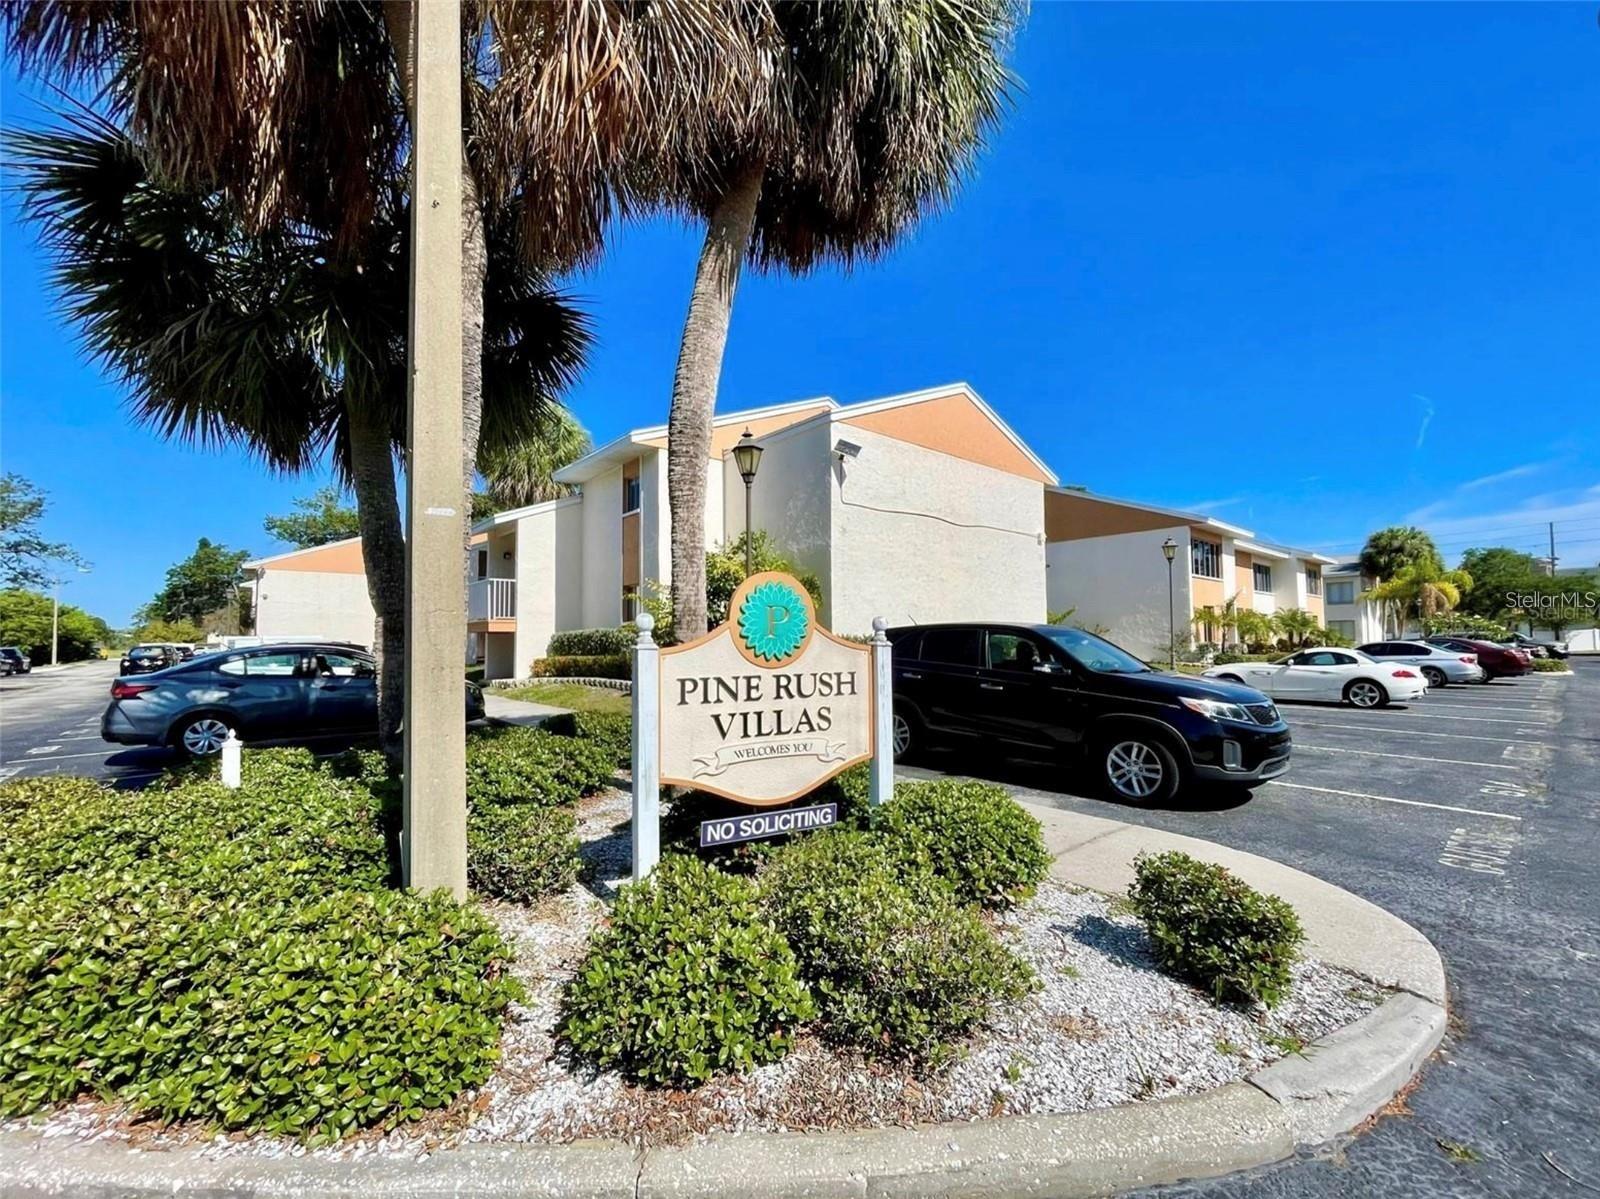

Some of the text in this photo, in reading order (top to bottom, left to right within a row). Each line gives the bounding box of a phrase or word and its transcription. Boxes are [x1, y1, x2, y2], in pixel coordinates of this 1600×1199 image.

[763, 604, 790, 640] P
[676, 671, 858, 706] PINE RUSH
[710, 706, 833, 741] VILLAS
[733, 742, 814, 759] WELCOMES YOU
[706, 807, 833, 843] NO SOLICITING
